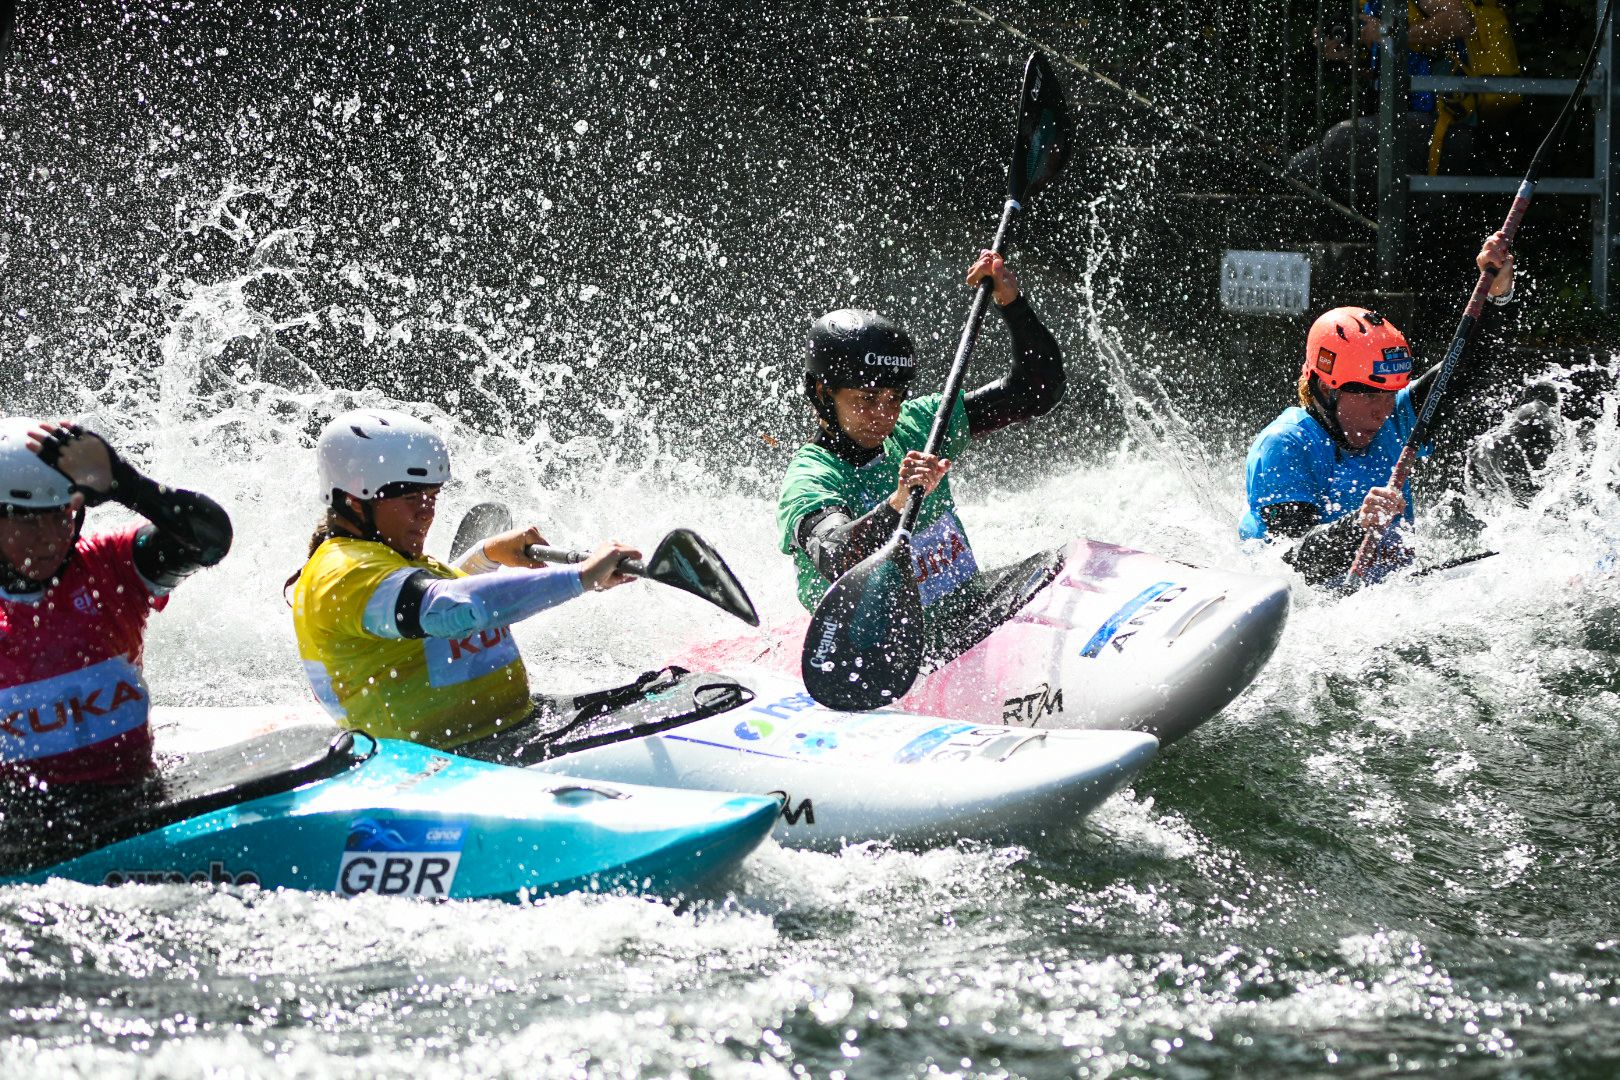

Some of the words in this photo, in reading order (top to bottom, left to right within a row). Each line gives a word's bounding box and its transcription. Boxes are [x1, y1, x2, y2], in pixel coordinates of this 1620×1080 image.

[864, 352, 914, 367] Creand
[1438, 338, 1466, 391] paddles
[810, 621, 838, 669] Creand
[0, 680, 144, 738] KUKA
[1002, 682, 1064, 728] RTM
[425, 828, 462, 842] canoe
[340, 856, 451, 897] GBR
